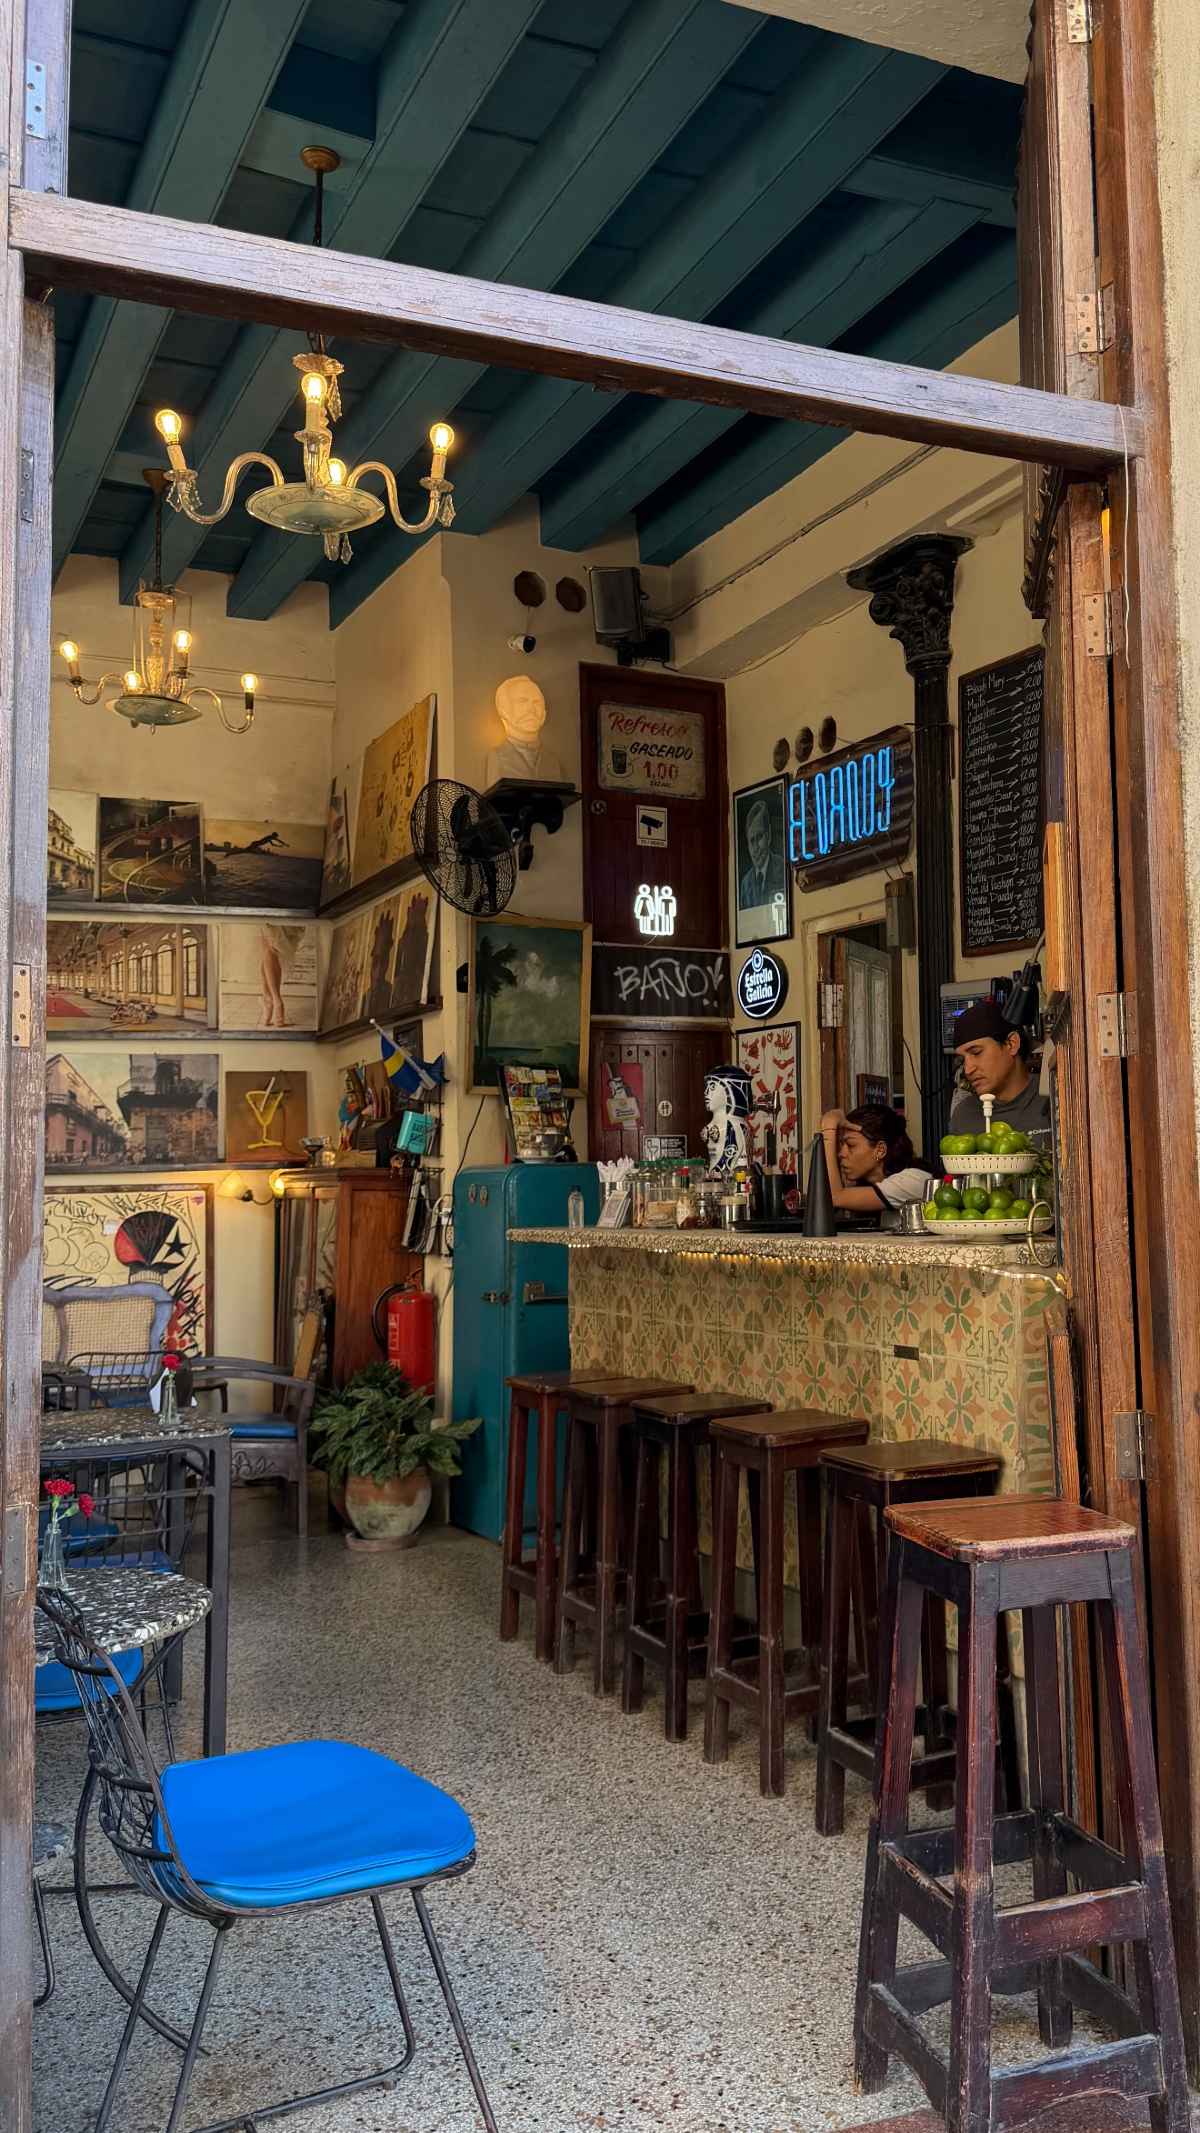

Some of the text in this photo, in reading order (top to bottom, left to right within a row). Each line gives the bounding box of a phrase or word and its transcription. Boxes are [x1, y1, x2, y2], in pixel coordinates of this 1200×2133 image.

[629, 741, 694, 761] GASEADO
[744, 969, 773, 988] Estrella
[746, 984, 773, 1003] Galicia
